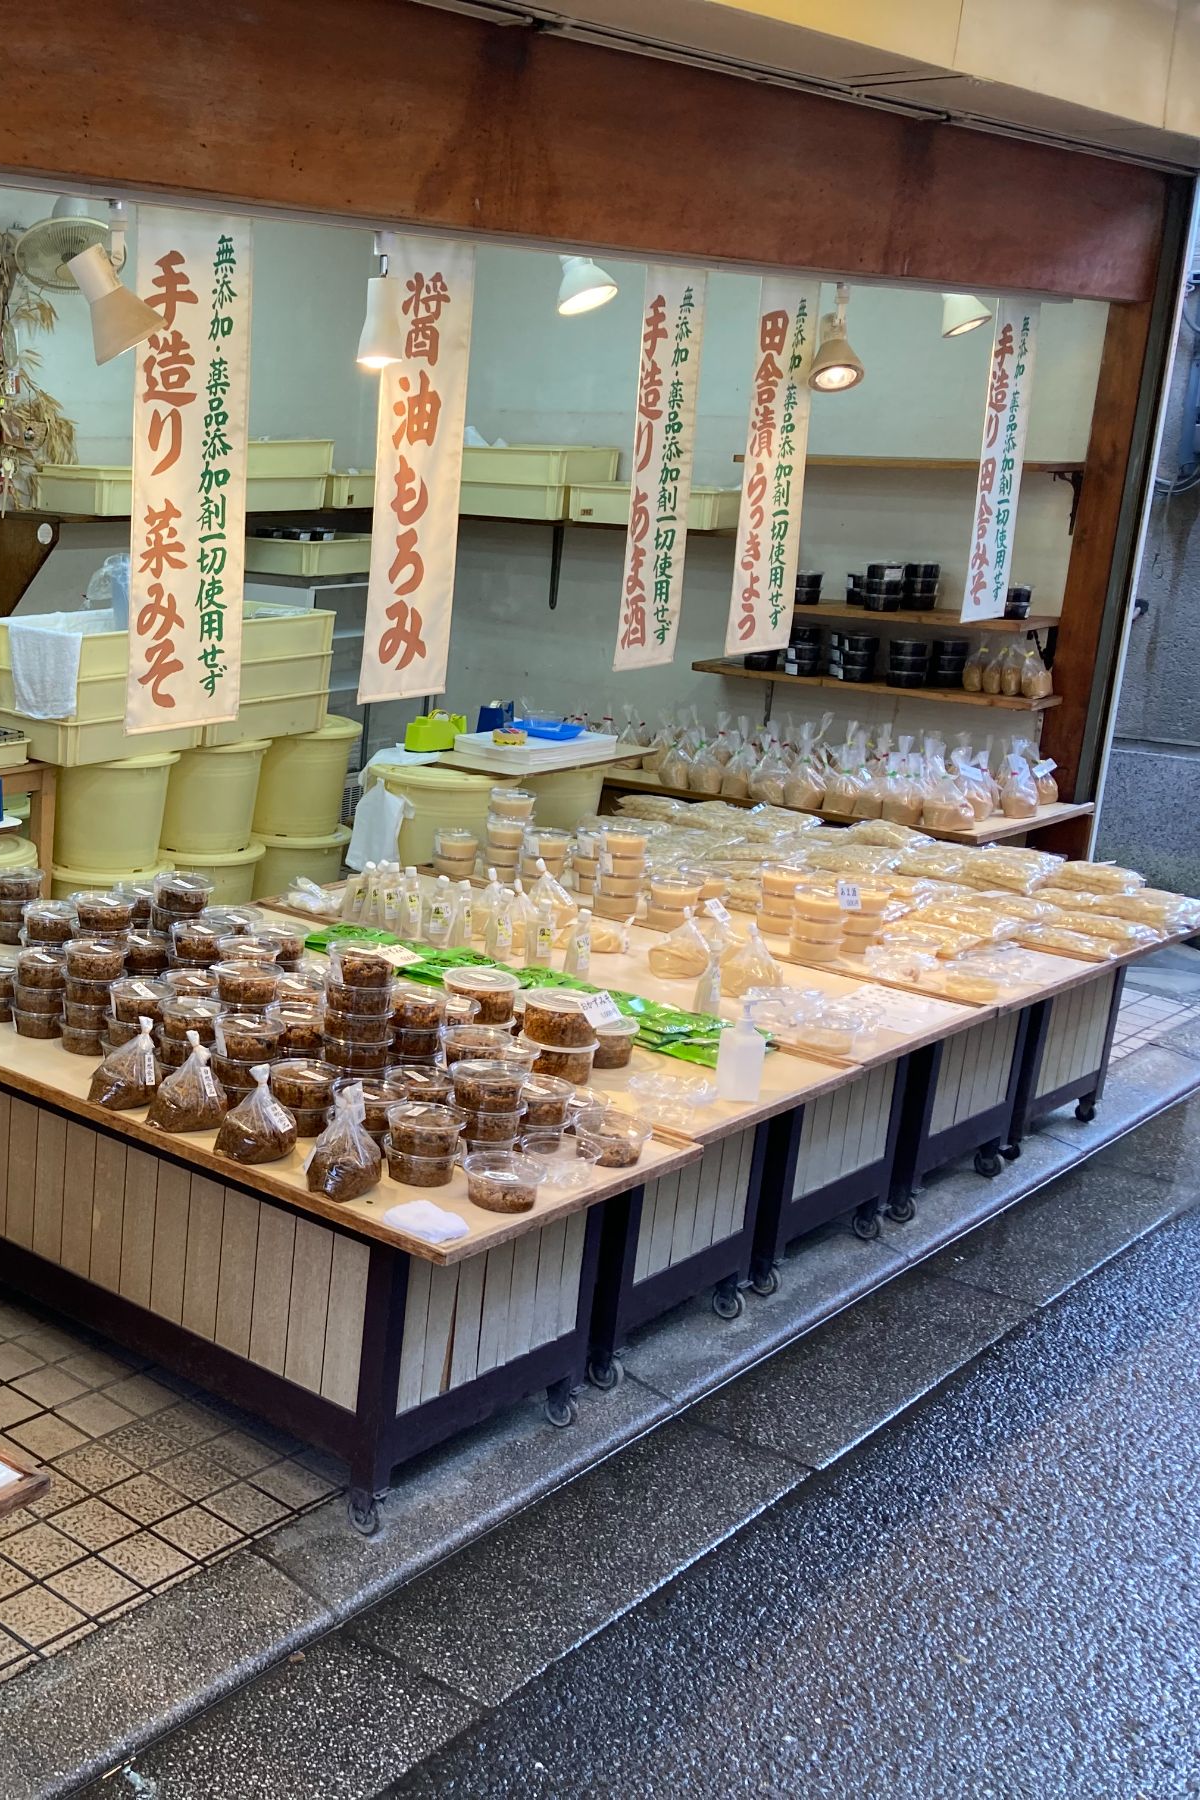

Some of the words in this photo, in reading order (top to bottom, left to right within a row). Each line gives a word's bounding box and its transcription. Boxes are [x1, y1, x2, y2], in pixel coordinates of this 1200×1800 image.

[195, 234, 239, 698] 無添加・薬品添加剤一切使用せず
[379, 271, 452, 671] 醤油もろみ
[653, 286, 694, 646] 無添加・薬品添加剤一切使用せず
[737, 309, 790, 641] 田舎漬らっきょう
[768, 297, 807, 631] 無添加・薬品添加剤一切使用せず
